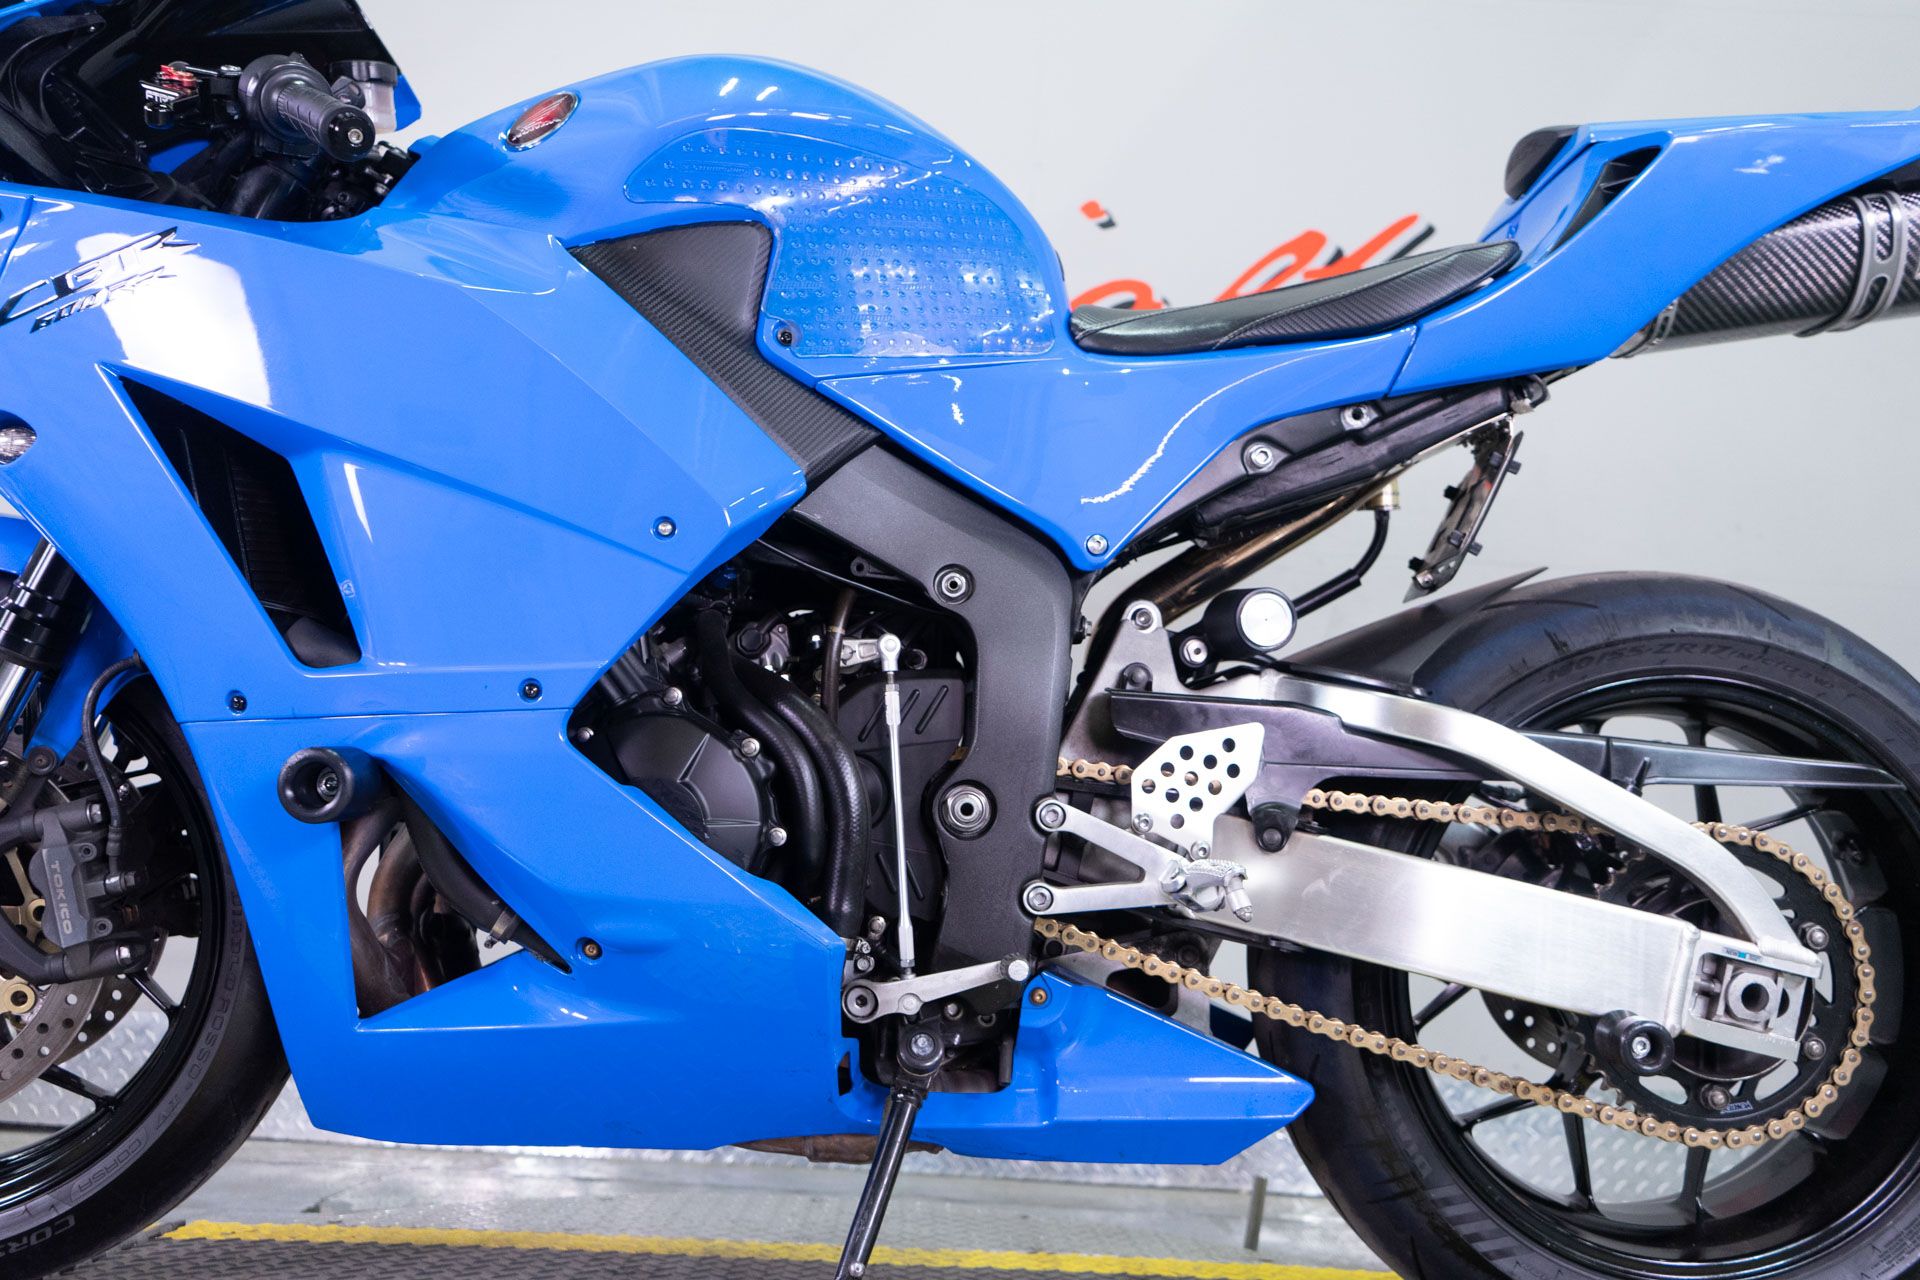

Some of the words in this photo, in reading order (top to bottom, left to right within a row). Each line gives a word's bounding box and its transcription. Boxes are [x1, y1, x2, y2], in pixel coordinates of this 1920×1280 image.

[0, 226, 201, 327] CBR
[50, 860, 73, 935] TOKICO
[188, 1001, 231, 1081] ROSSO
[78, 1138, 142, 1193] CORSA
